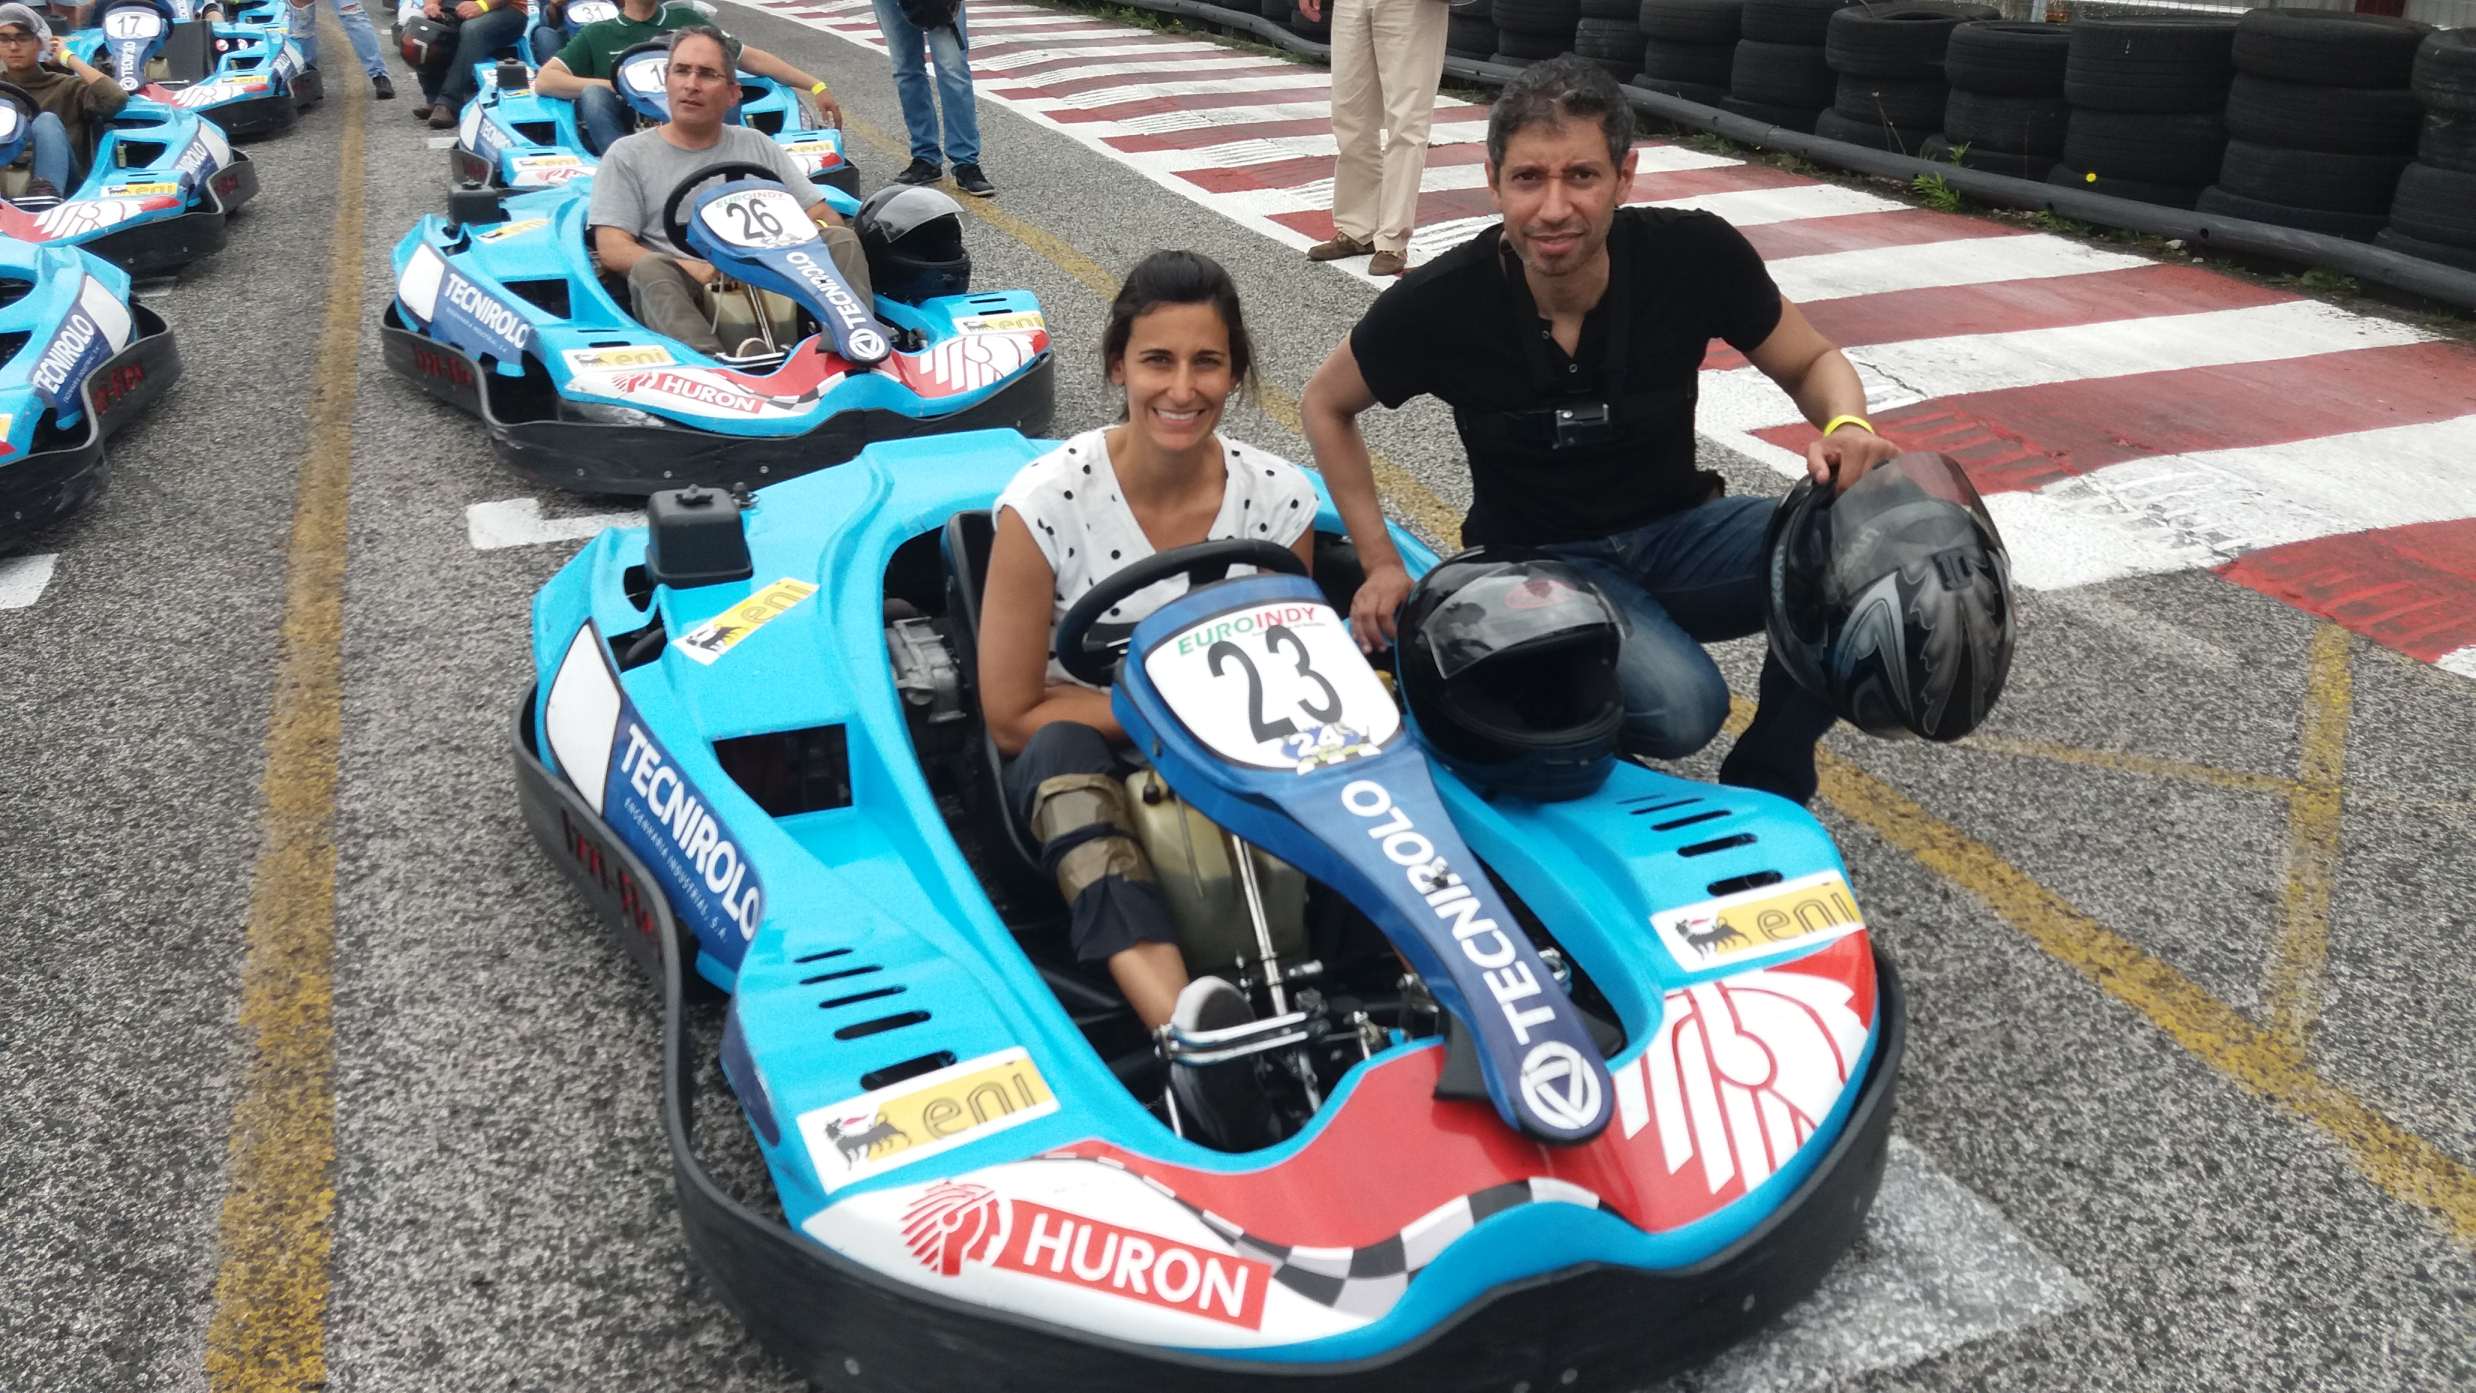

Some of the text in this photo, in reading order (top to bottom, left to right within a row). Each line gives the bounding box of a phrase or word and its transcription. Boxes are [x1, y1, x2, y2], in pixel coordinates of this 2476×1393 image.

[117, 16, 141, 37] 17
[726, 198, 783, 240] 26
[445, 273, 529, 349] TECNIROLO
[786, 251, 867, 330] TECNIROLO
[661, 375, 756, 412] HURON
[740, 582, 813, 624] eni
[1177, 607, 1318, 656] EUROINDY
[1207, 624, 1342, 745] 23
[620, 723, 760, 941] TECNIROLO
[1341, 779, 1556, 1045] TECNIROLO
[1757, 882, 1858, 942] eni
[922, 1061, 1038, 1140] eni
[1023, 1213, 1249, 1318] HURON
